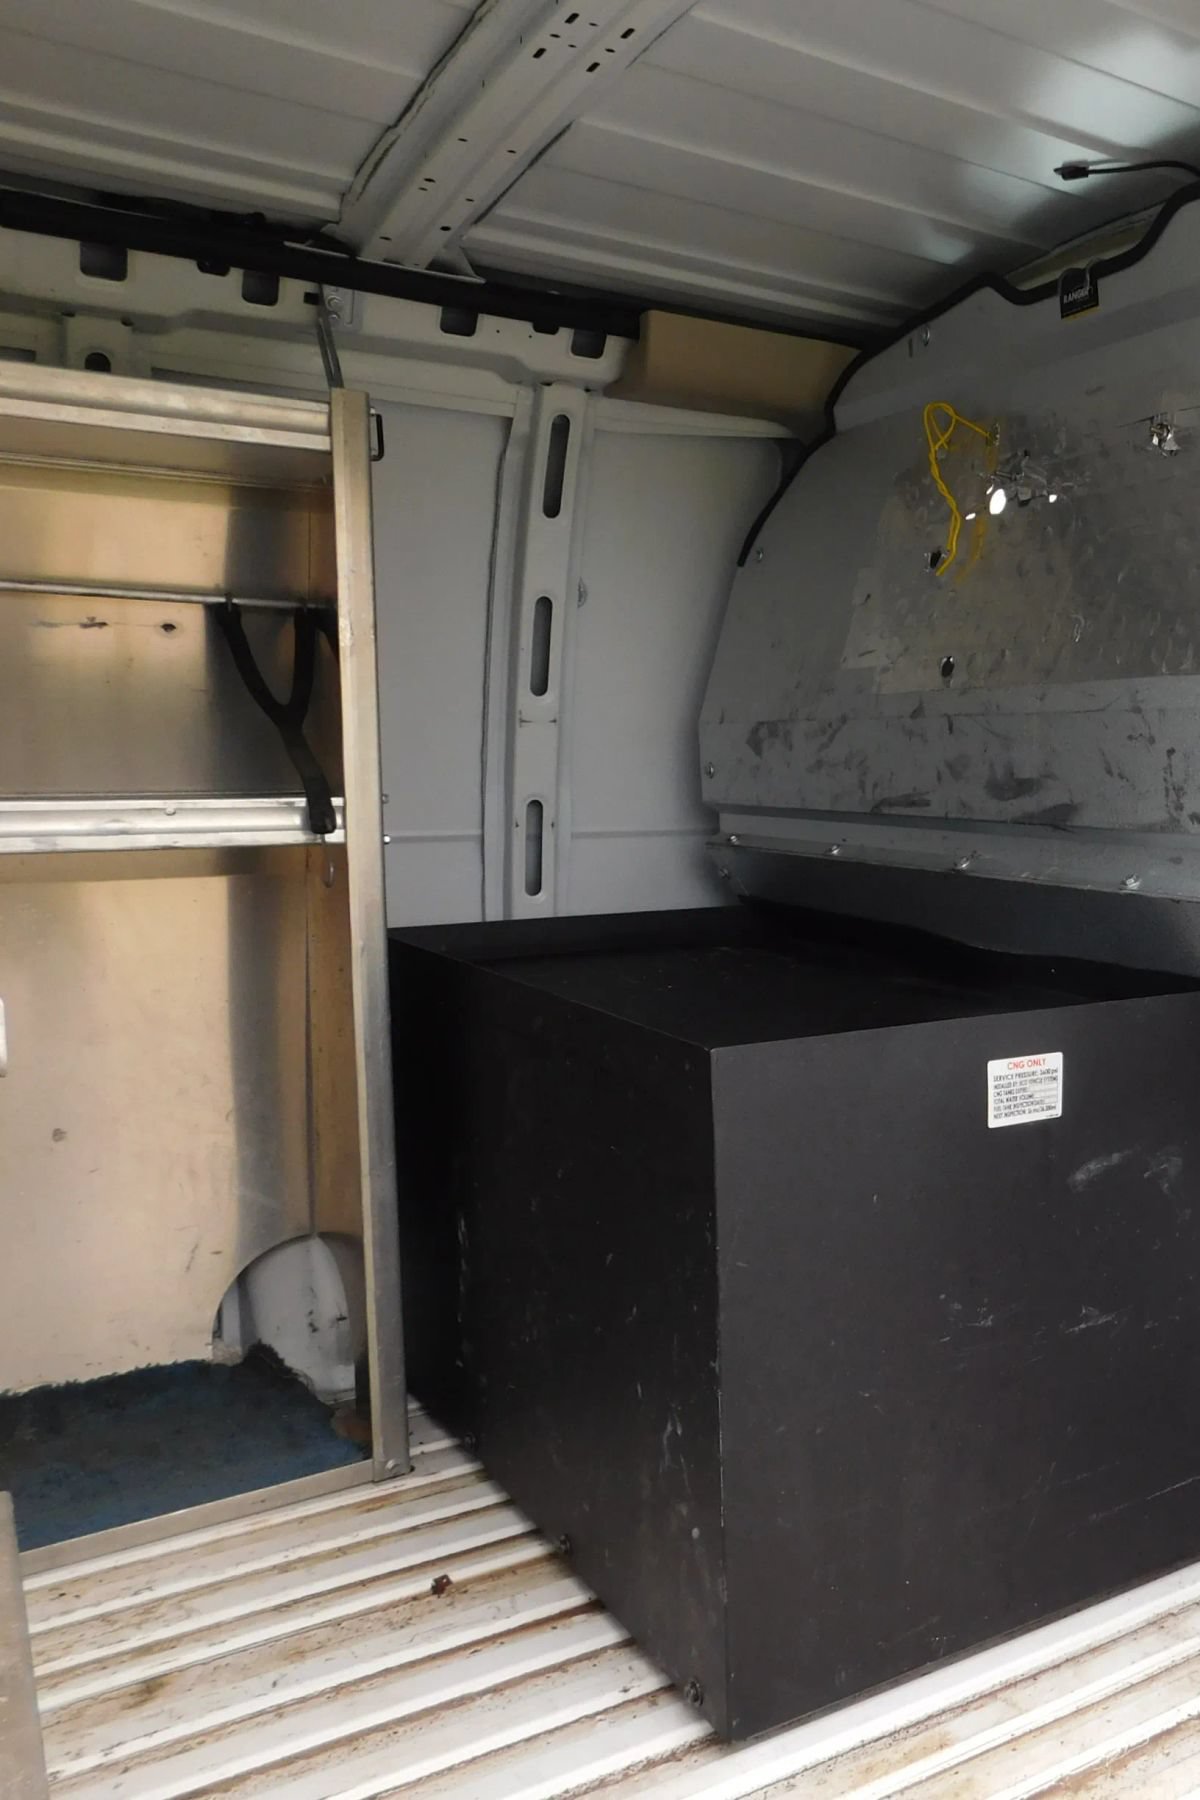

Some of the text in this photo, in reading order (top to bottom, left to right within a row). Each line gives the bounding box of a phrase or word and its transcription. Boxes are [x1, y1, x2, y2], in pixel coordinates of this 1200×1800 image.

[1007, 1058, 1046, 1070] CNG ONLY
[993, 1073, 1013, 1082] SERVICE
